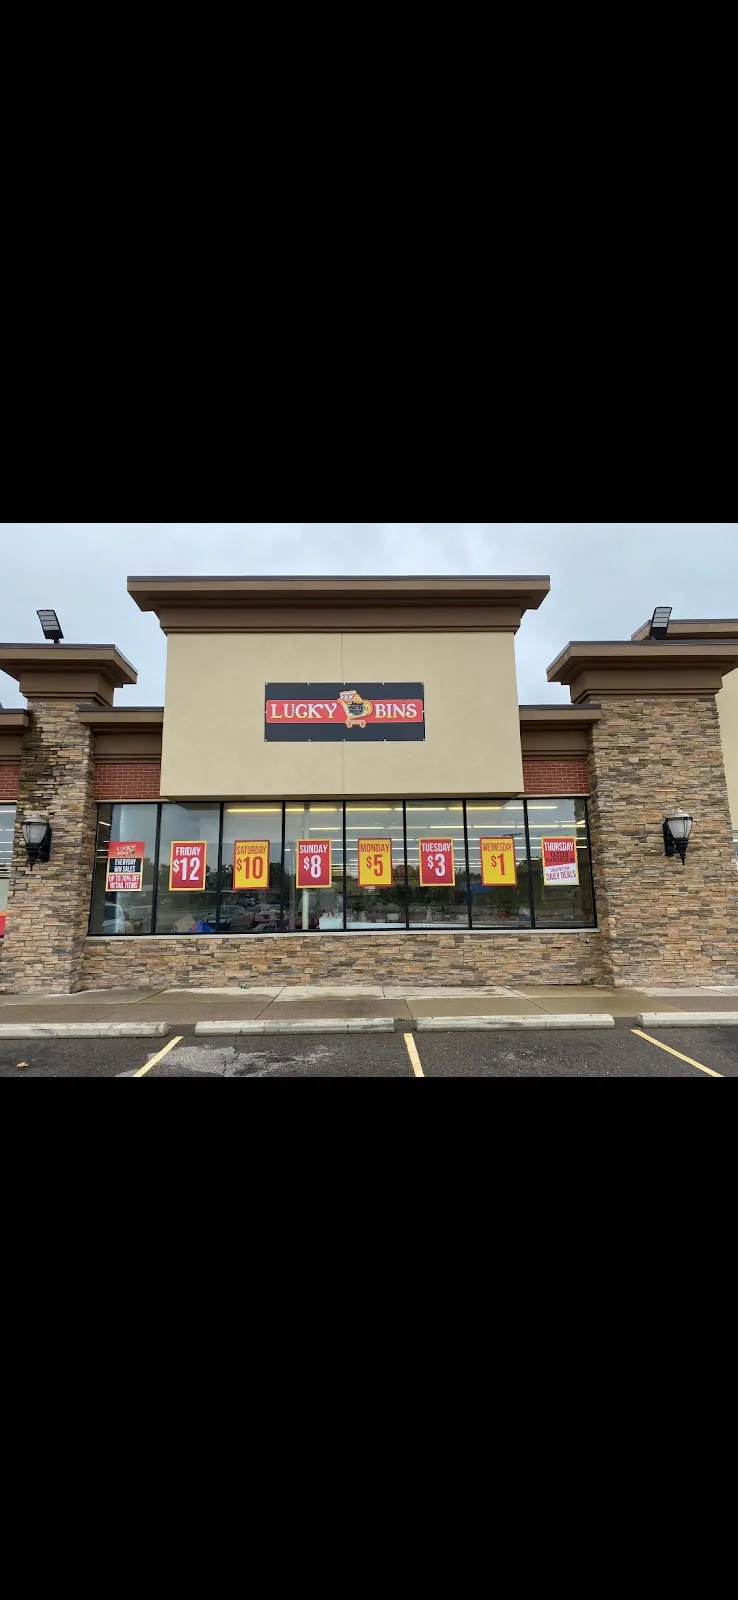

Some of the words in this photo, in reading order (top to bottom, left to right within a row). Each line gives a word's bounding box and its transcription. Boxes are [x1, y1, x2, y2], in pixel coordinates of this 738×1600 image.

[270, 703, 337, 719] LUCKY
[375, 703, 418, 719] BINS
[175, 846, 202, 856] FRIDAY
[236, 845, 266, 855] SATURDAY
[299, 844, 328, 854] SUNDAY
[360, 843, 390, 853] MONDAY
[421, 842, 451, 852] TUESDAY
[482, 842, 512, 852] WEDNESDAY
[544, 842, 574, 851] THURSDAY
[172, 857, 200, 881] $12
[236, 856, 263, 879] $10
[303, 854, 322, 878] $8
[366, 854, 384, 877] $5
[427, 853, 446, 877] $3
[490, 853, 506, 876] $1
[546, 872, 560, 880] DAILY
[560, 870, 576, 879] DEALS
